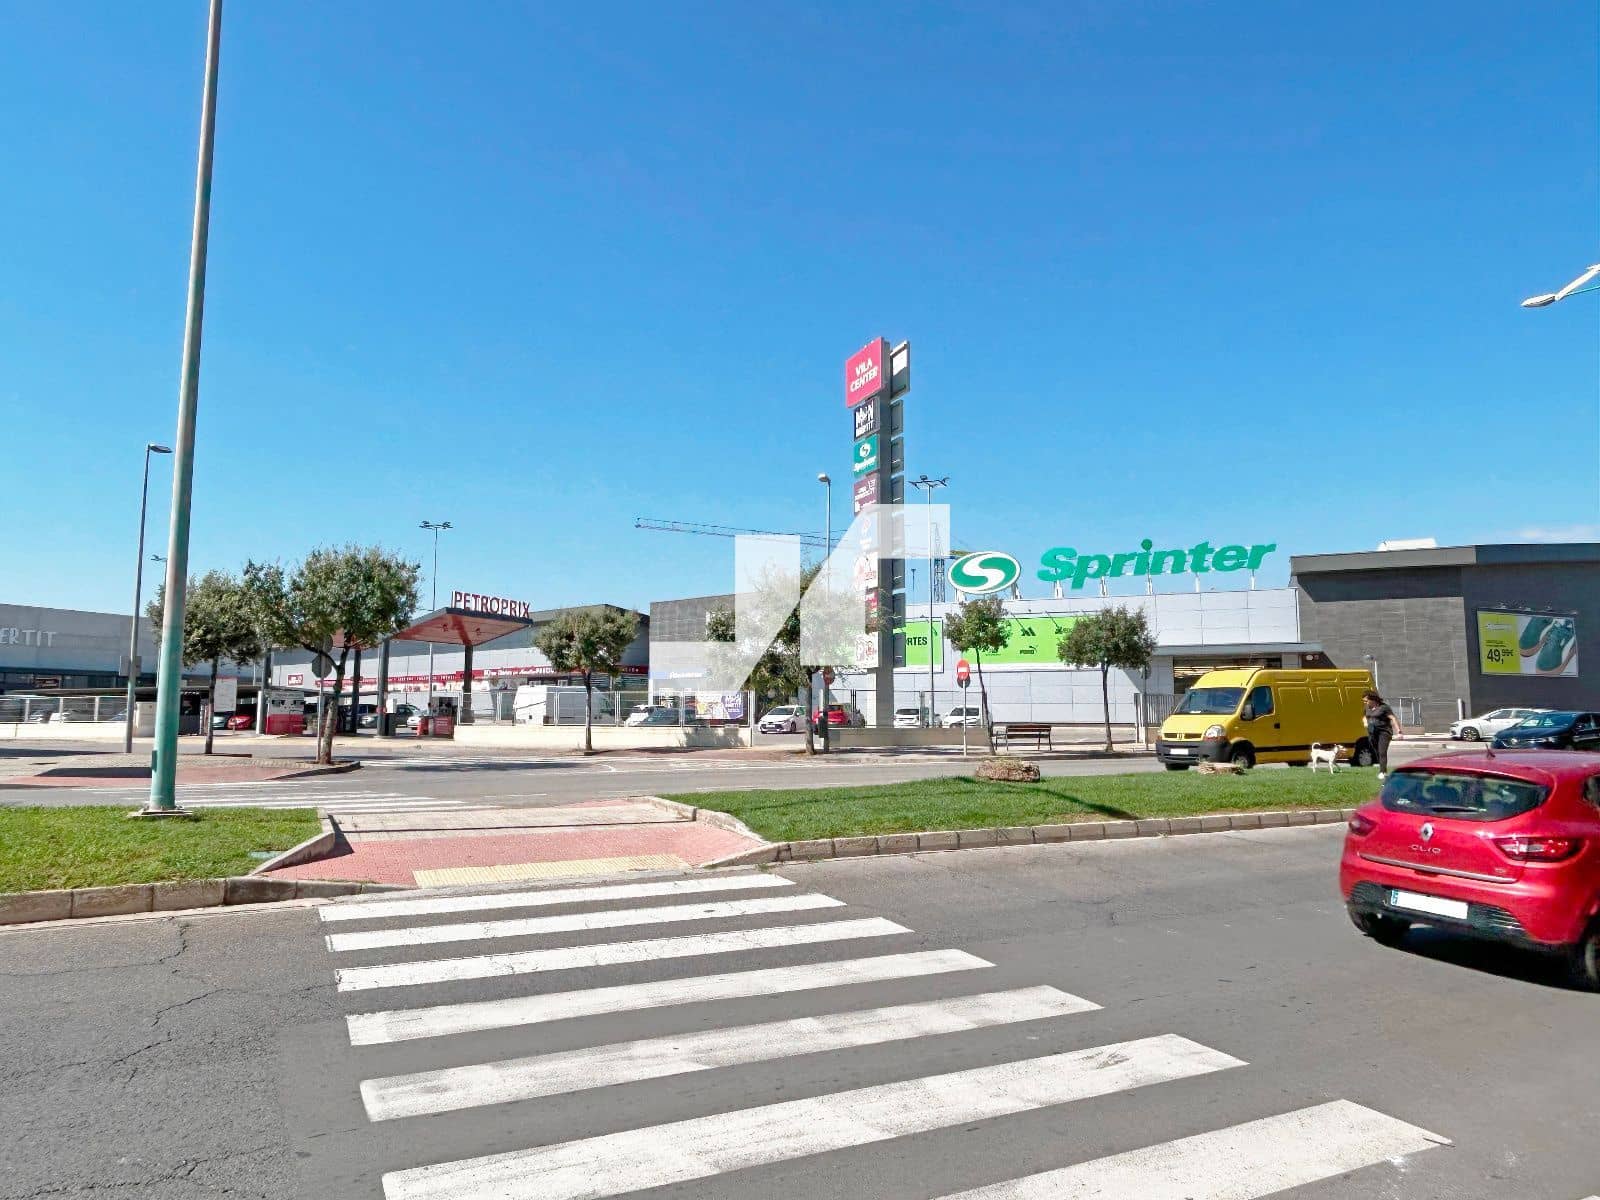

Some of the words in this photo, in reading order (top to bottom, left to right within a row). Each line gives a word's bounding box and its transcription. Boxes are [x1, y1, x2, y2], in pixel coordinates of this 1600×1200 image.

[850, 366, 878, 392] CENTER
[855, 357, 873, 377] VILA
[1037, 538, 1277, 590] Sprinter
[452, 590, 530, 618] PETROPRIX
[1408, 844, 1441, 854] CLIO
